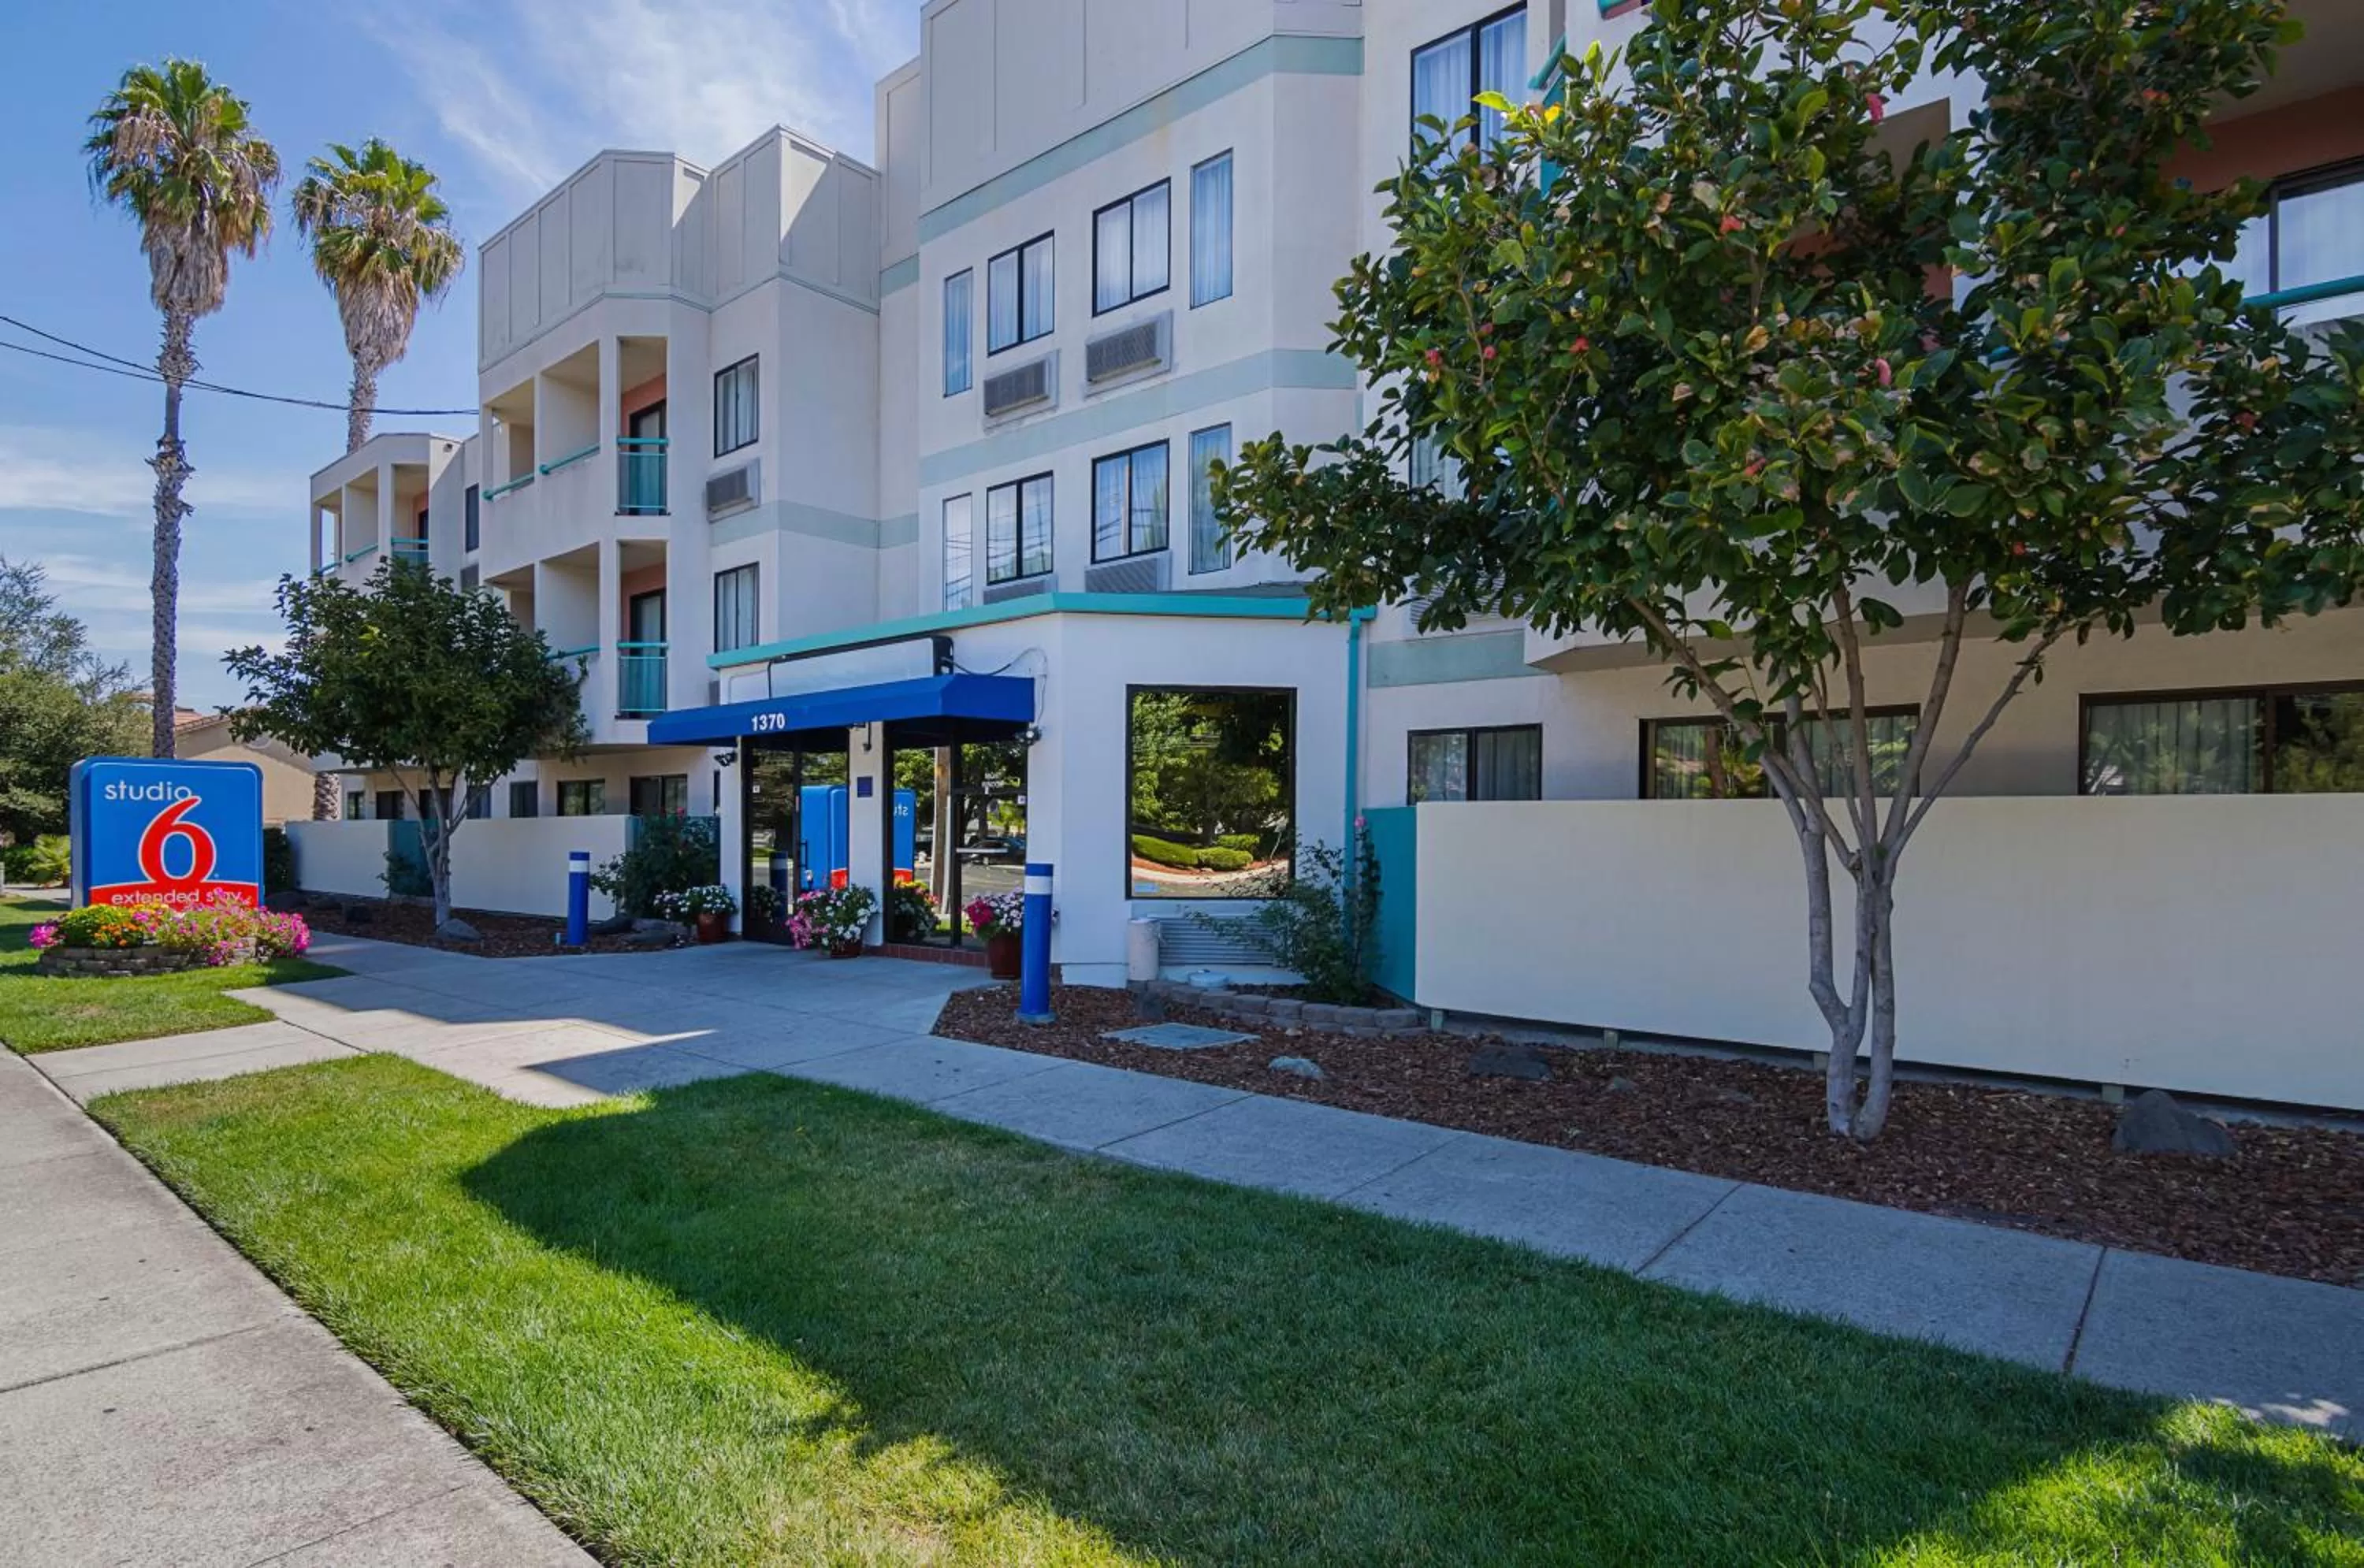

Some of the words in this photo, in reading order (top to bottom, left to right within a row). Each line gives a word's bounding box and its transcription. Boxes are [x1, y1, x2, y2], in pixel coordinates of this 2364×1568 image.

[751, 712, 786, 731] 1370
[104, 779, 192, 801] studio
[138, 795, 217, 883] 6
[110, 889, 199, 905] extended
[205, 887, 243, 905] say
